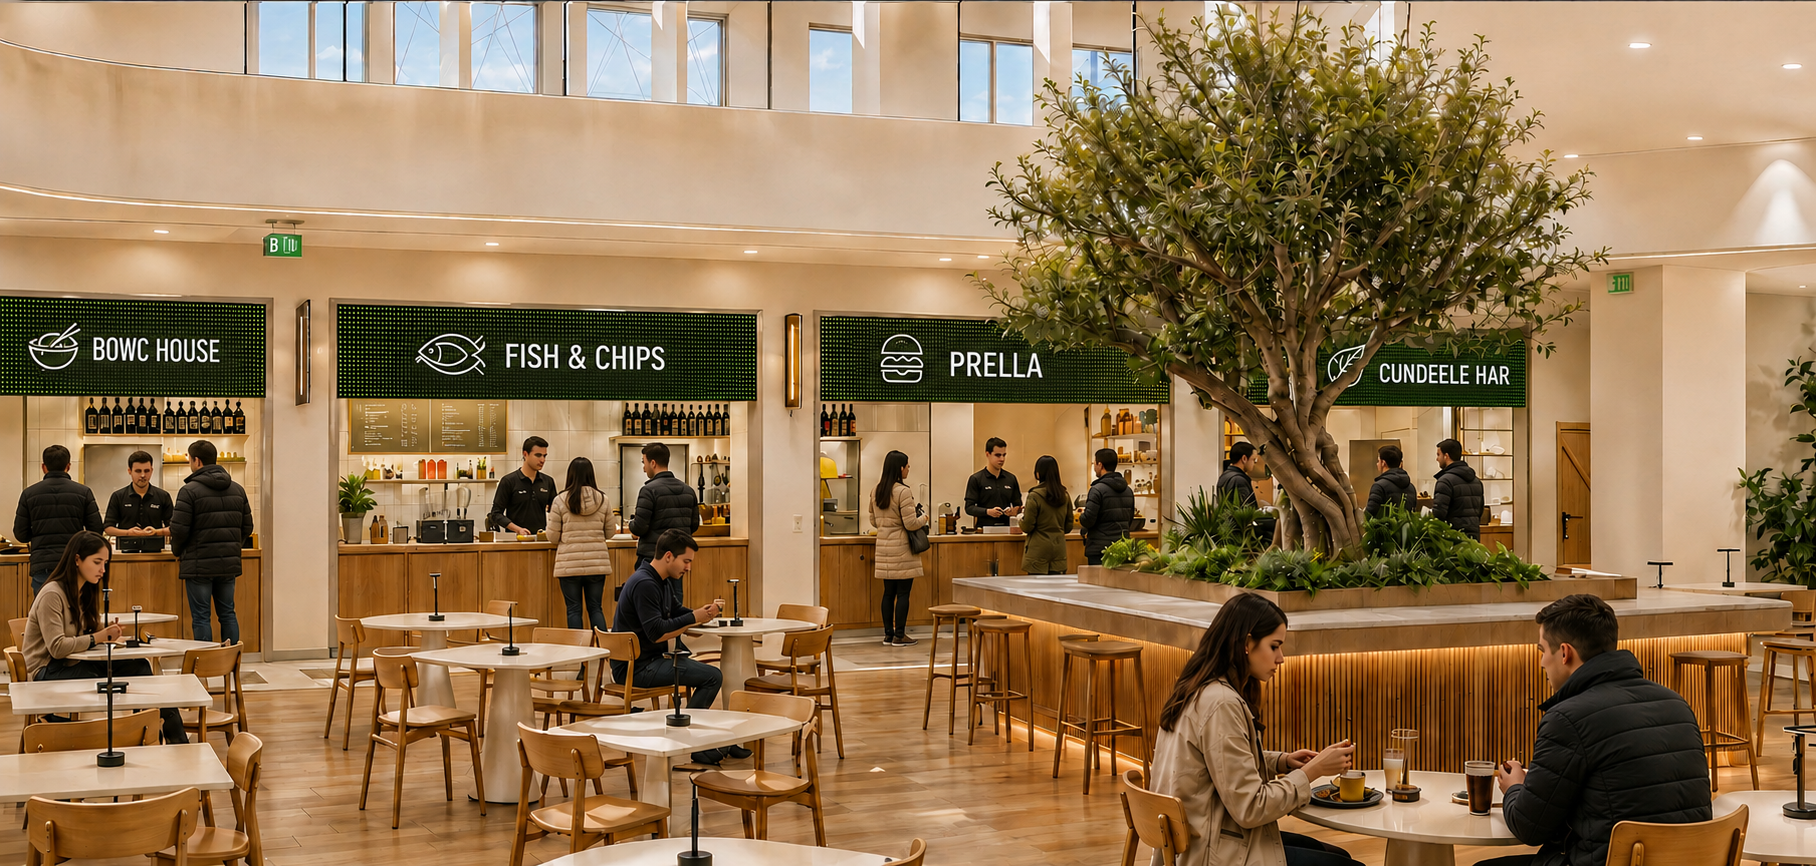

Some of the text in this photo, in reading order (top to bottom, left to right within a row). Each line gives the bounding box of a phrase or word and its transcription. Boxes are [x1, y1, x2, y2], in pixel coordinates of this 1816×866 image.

[93, 336, 220, 363] BOWC HOUSE
[505, 343, 665, 371] FISH & CHIPS
[950, 351, 1043, 379] PRELLA
[1379, 362, 1510, 385] CUNDEELE HAR
